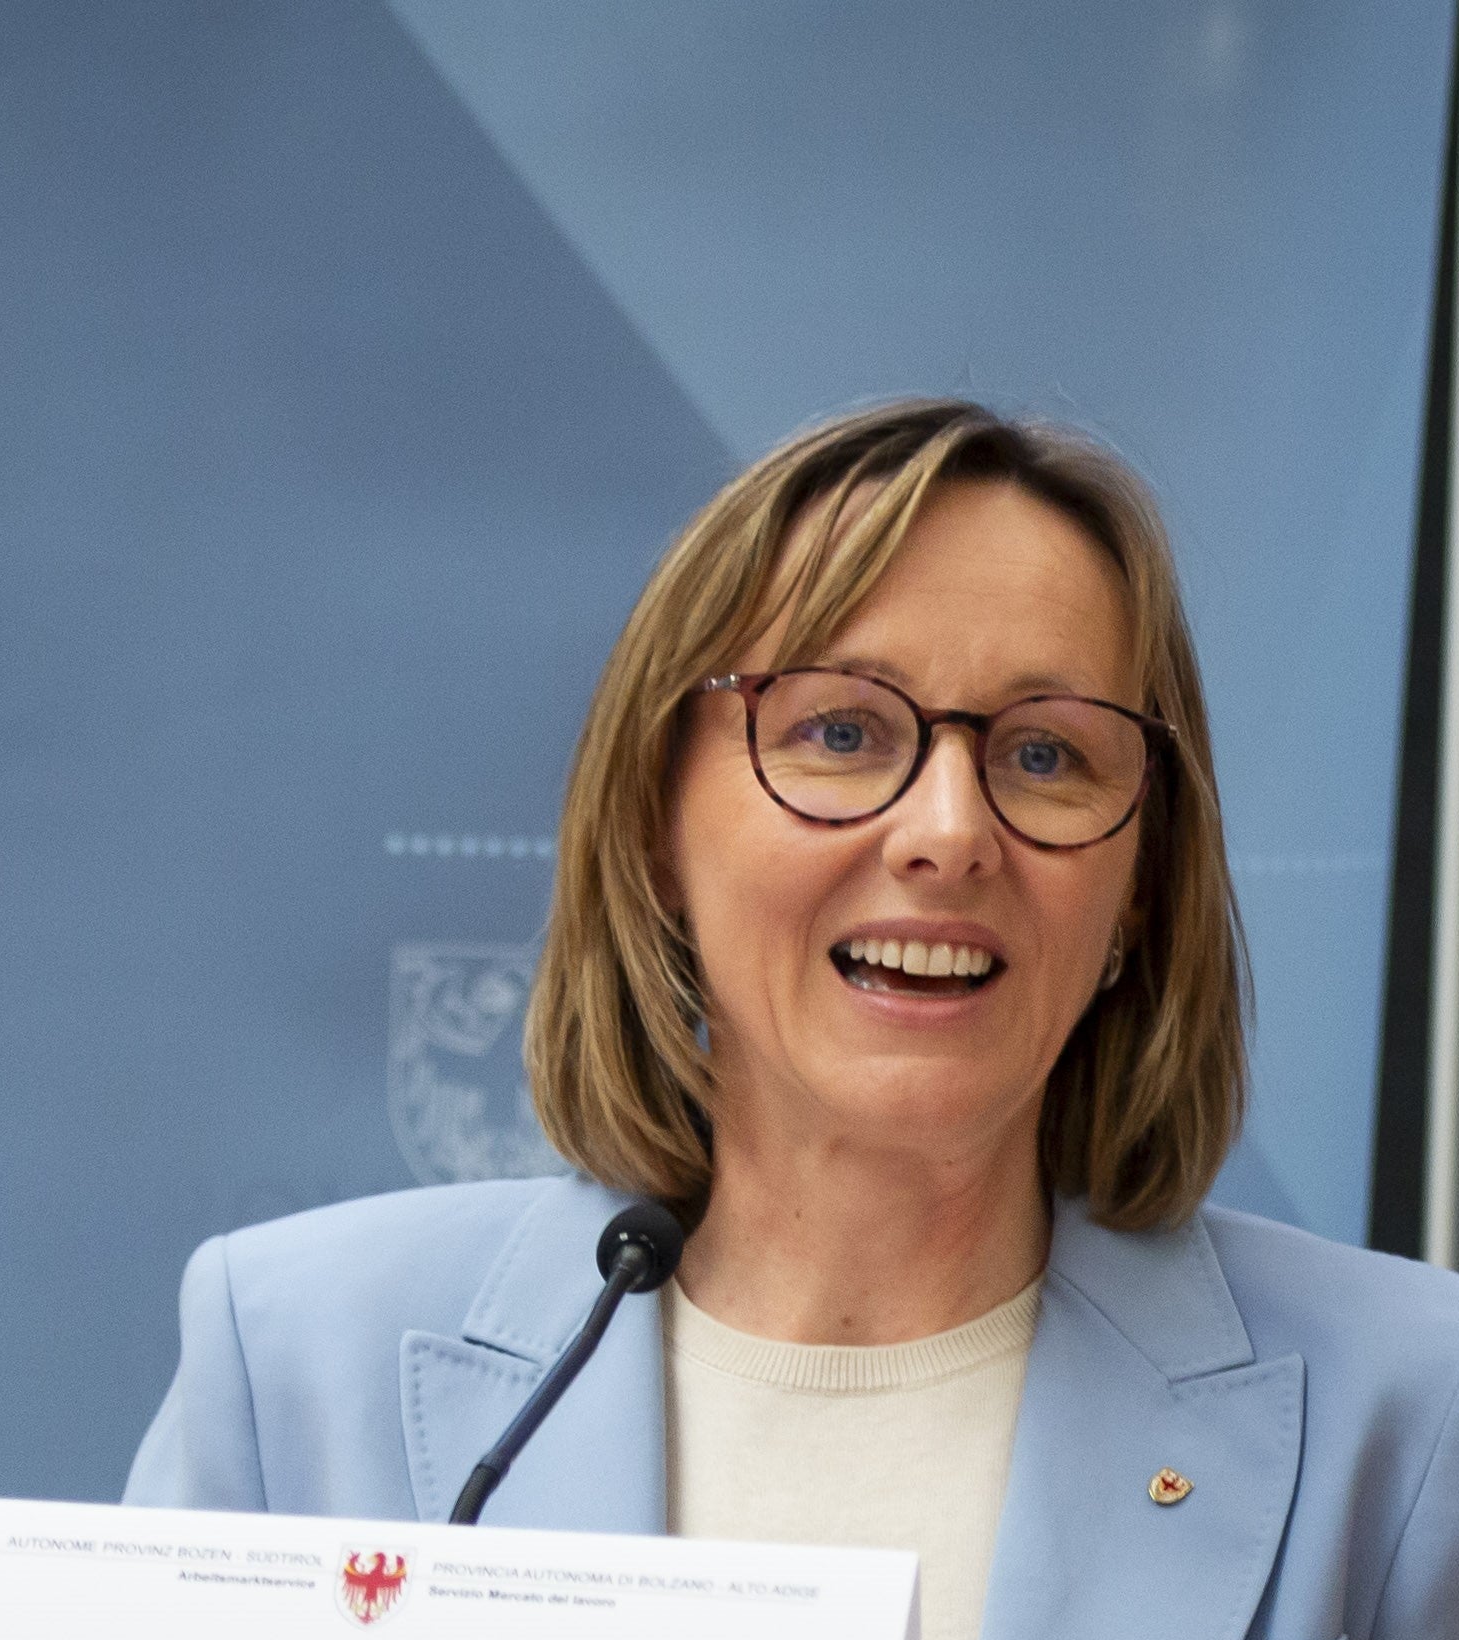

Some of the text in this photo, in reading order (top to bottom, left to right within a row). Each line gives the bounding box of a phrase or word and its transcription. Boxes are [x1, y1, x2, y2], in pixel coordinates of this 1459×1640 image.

[7, 1535, 95, 1553] AUTONOME
[102, 1541, 173, 1559] PROVINZ
[177, 1546, 232, 1562] BOZEN
[433, 1561, 820, 1600] PROVINCIA AUTONOMA DI BOLZANO ALTO ADIGE
[429, 1585, 616, 1608] Servizio Mercato del lavoro
